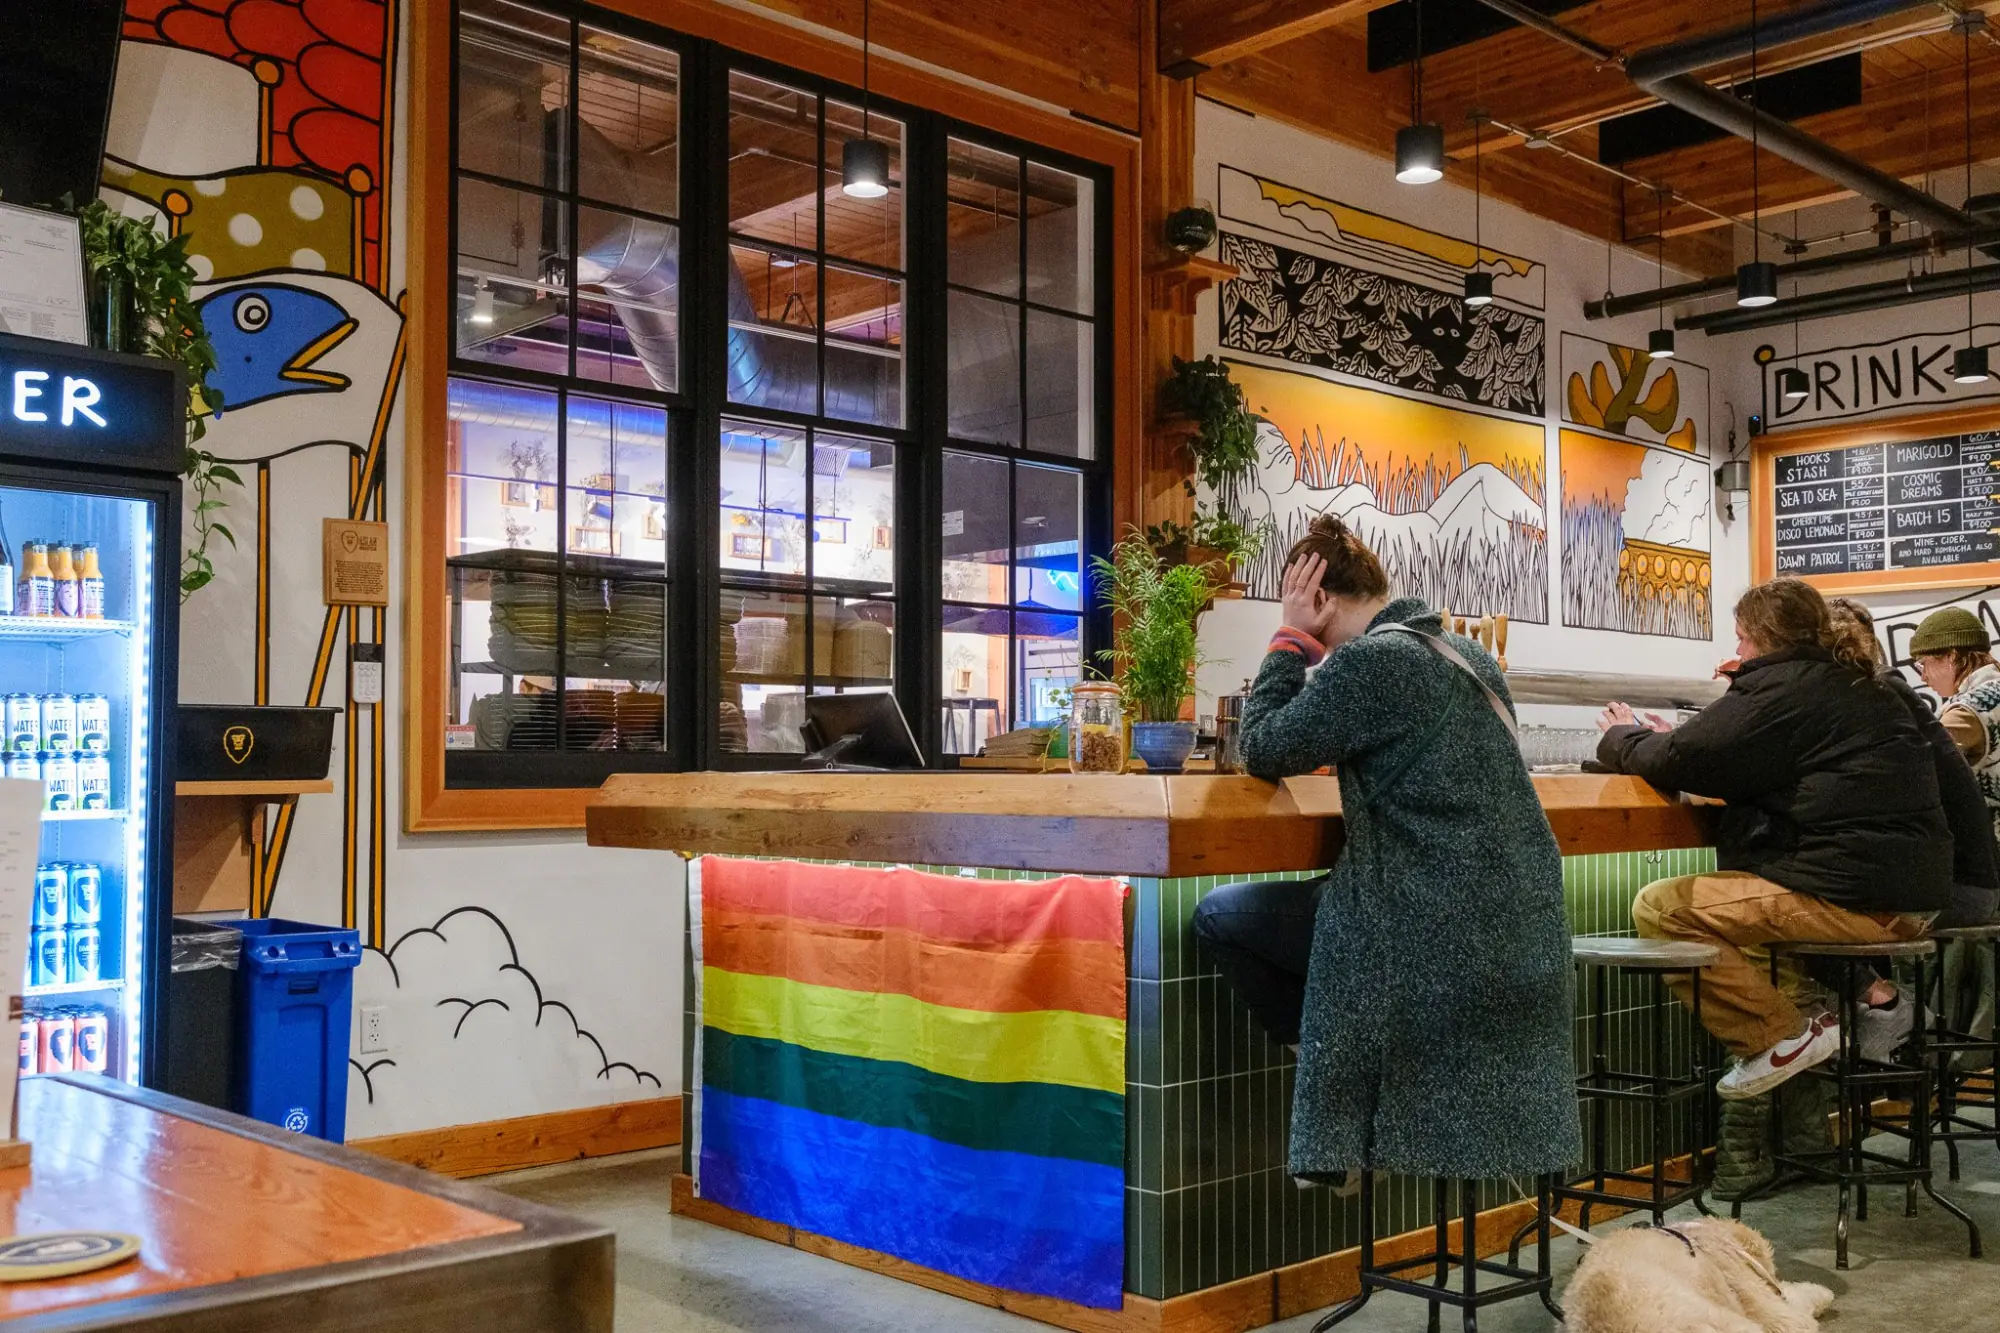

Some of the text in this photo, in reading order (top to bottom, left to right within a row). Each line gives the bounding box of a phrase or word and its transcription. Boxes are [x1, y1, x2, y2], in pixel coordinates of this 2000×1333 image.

[14, 371, 108, 427] ER
[1796, 452, 1831, 467] HOOK'S
[1896, 444, 1953, 462] MARIGOLD
[1968, 453, 1992, 462] $9.00
[1786, 465, 1827, 482] STASH
[1902, 472, 1942, 488] COSMIC
[1781, 487, 1838, 507] SEA TO SEA
[1901, 484, 1943, 499] DREAMS
[1968, 485, 1994, 496] $9.00
[1791, 515, 1817, 527] CHERRY
[1896, 508, 1951, 528] BATCH 15
[1969, 520, 1992, 529] $9.00
[1777, 523, 1846, 541] DISCO LEMONADE
[1855, 530, 1875, 539] $9.00
[1899, 542, 1993, 558] AND HARD KOMBUCHA ALSO
[1778, 551, 1844, 570] DAWN PATROL
[1921, 554, 1960, 564] AVAILABLE
[82, 719, 108, 732] WATR
[81, 778, 108, 791] WATR
